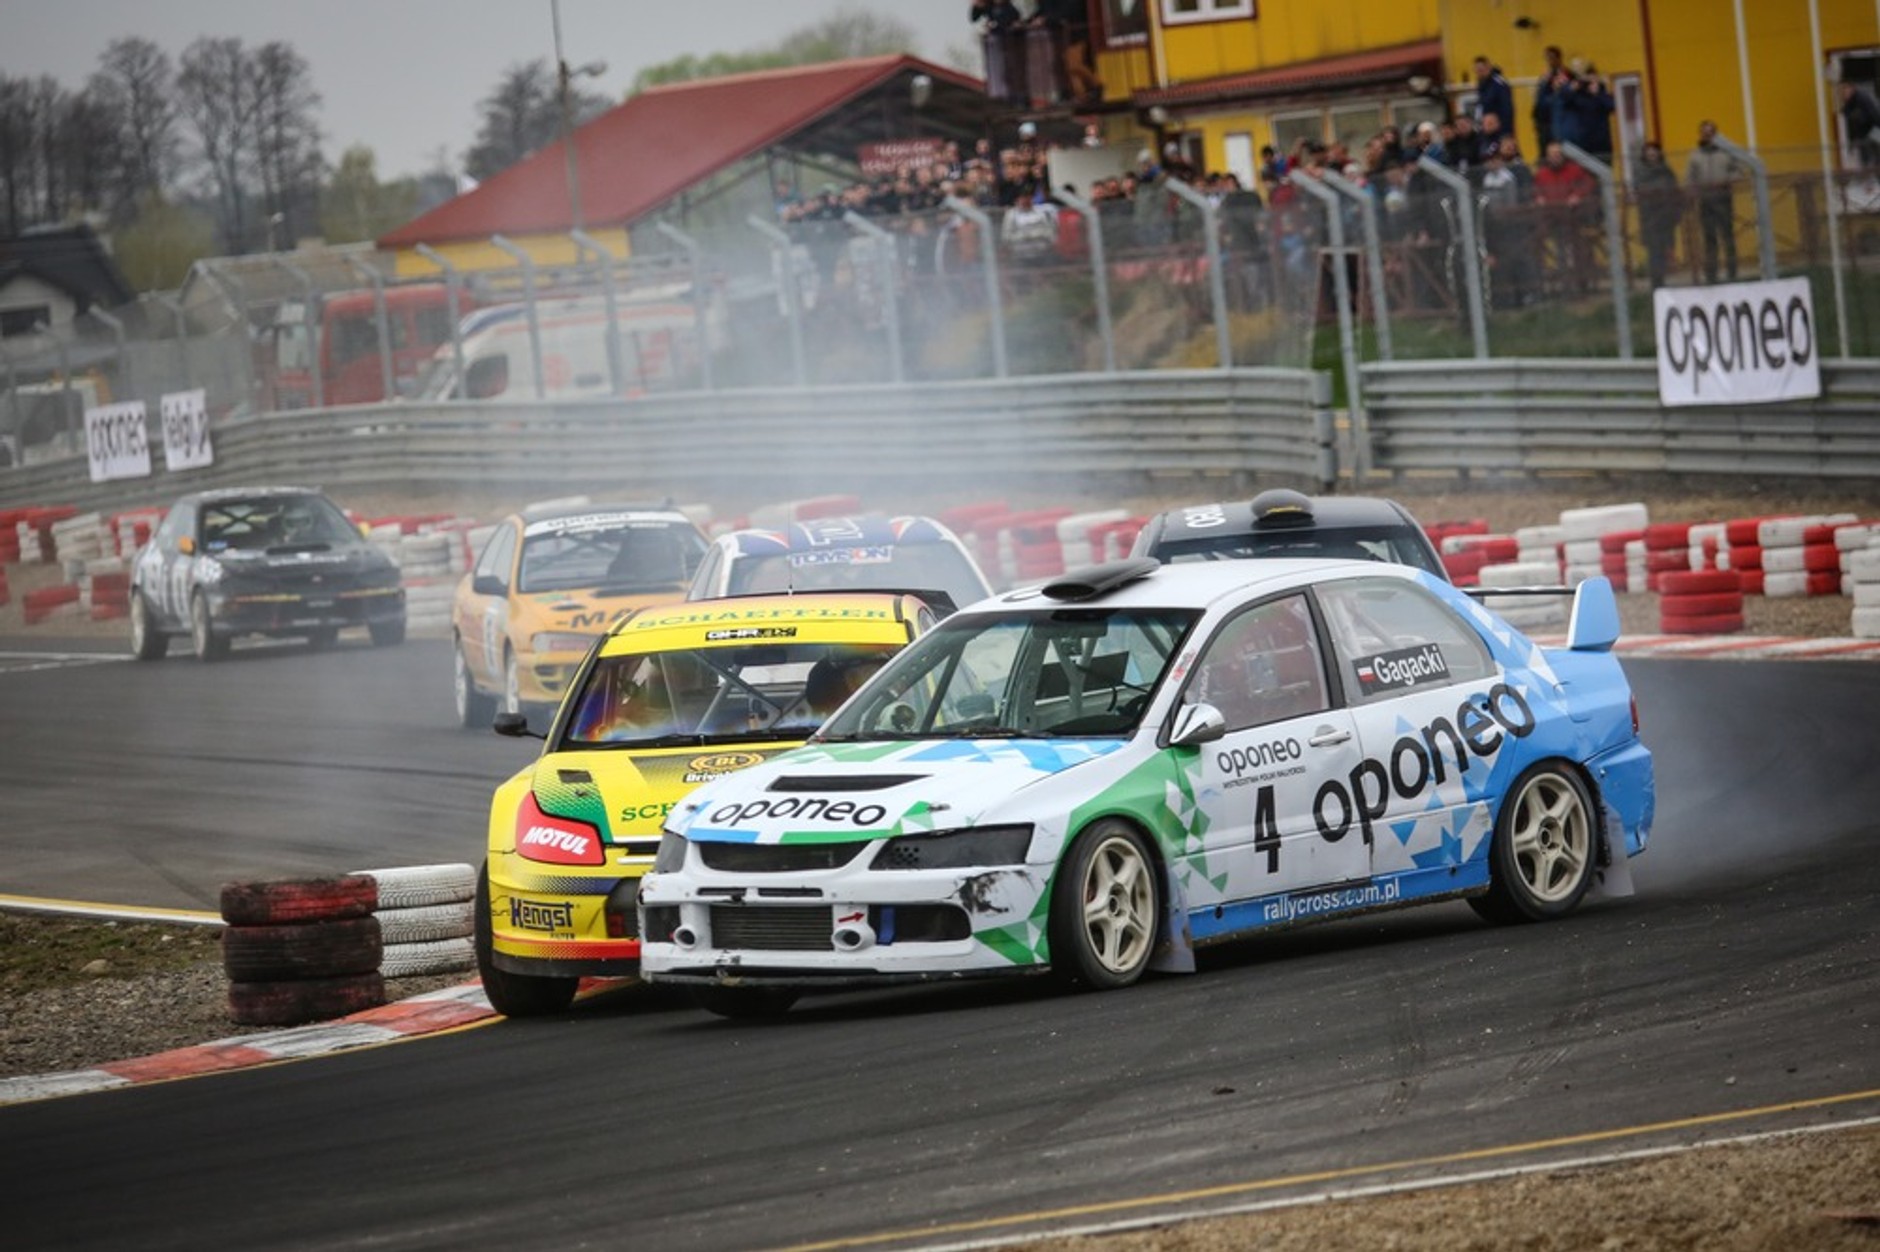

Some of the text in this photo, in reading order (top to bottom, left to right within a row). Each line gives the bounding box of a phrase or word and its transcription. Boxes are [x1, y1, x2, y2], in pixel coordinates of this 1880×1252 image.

[1665, 296, 1812, 395] oponeo
[636, 609, 887, 628] SCHAEFFLER
[1374, 645, 1446, 686] Gagacki
[1217, 737, 1302, 777] oponeo
[1313, 683, 1536, 846] oponeo
[710, 799, 887, 827] oponeo
[1254, 785, 1282, 874] 4
[522, 826, 590, 856] MOTUL
[510, 897, 574, 931] Hengst
[1264, 878, 1400, 921] rallycross.com.pl
